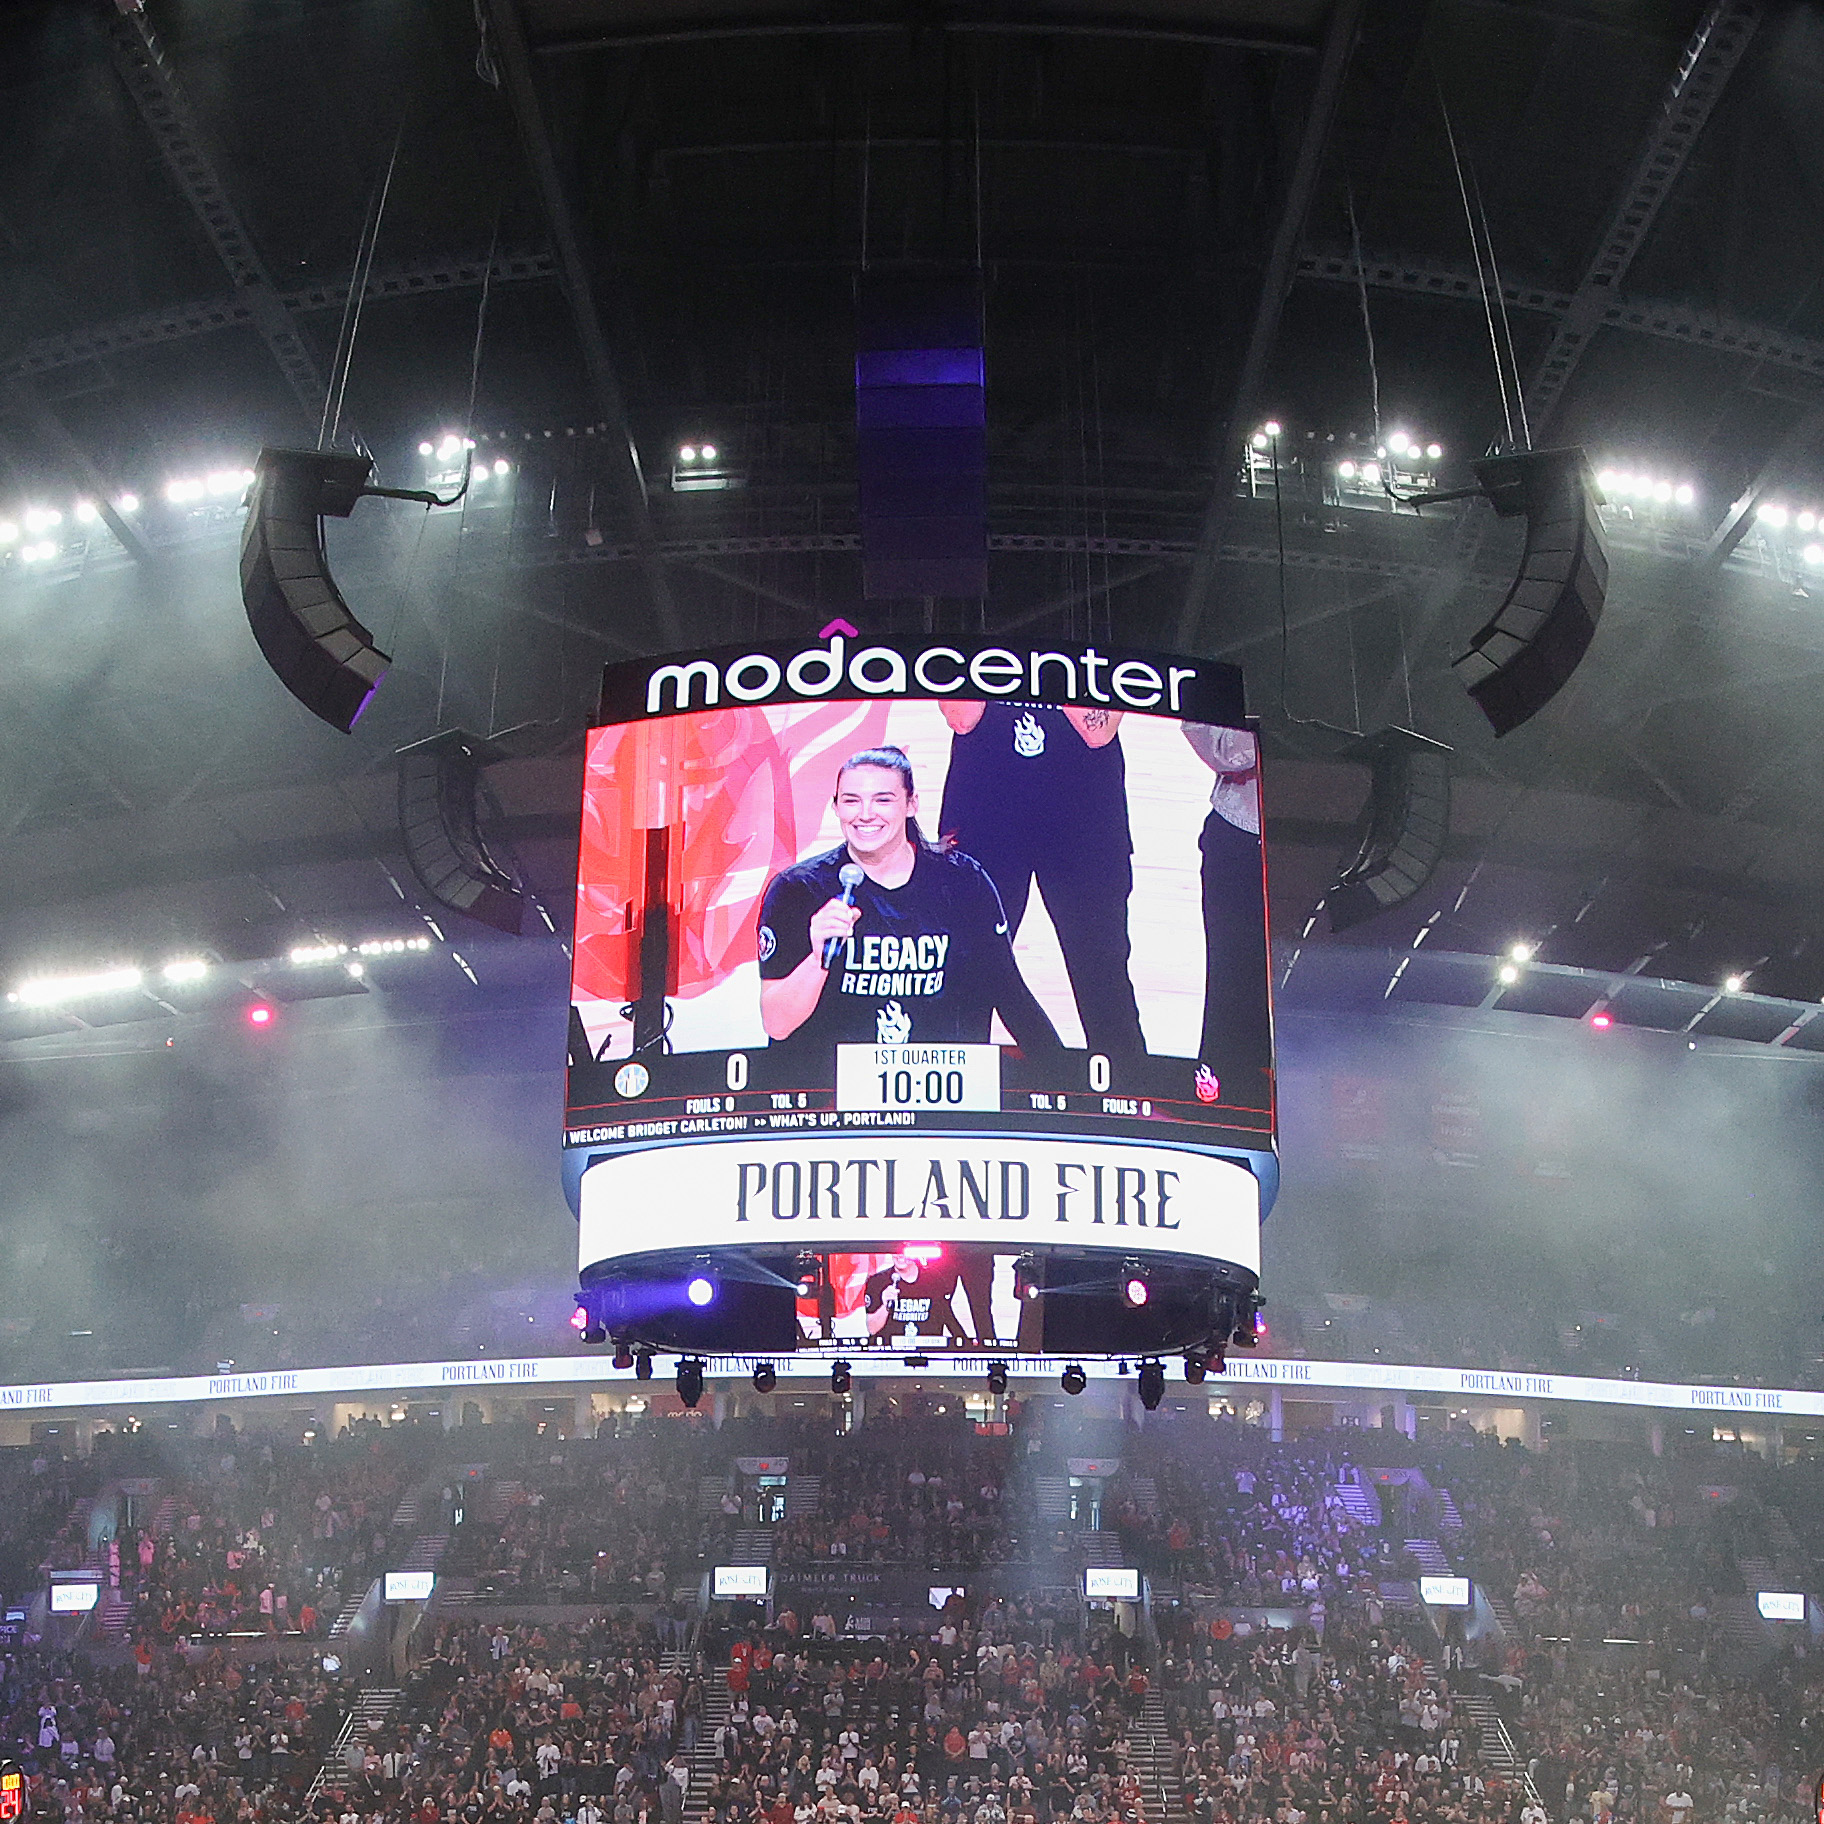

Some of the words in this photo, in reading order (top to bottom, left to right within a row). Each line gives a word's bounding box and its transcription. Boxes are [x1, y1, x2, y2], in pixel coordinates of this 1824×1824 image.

[647, 636, 1196, 712] modacenter
[845, 934, 949, 971] LEGACY
[840, 970, 945, 997] REIGNITED
[874, 1050, 898, 1066] 1ST
[902, 1050, 966, 1065] QUARTER
[727, 1053, 749, 1091] 0
[1088, 1054, 1110, 1092] 0
[878, 1070, 963, 1104] 10:00
[686, 1097, 721, 1114] FOULS
[725, 1096, 735, 1112] 0
[771, 1093, 793, 1109] TOL
[797, 1093, 807, 1108] 5
[1029, 1093, 1052, 1110] TOL
[1102, 1098, 1137, 1115] FOULS
[1142, 1100, 1152, 1116] 0
[570, 1128, 624, 1144] WELCOME
[628, 1120, 678, 1138] BRIDGET
[680, 1116, 747, 1134] CARLETON!
[769, 1113, 817, 1128] WHAT'S
[820, 1112, 841, 1127] UP,
[844, 1111, 916, 1126] PORTLAND!
[735, 1158, 1029, 1222] PORTLAND
[1054, 1162, 1181, 1230] FIRE
[894, 1298, 931, 1312] LEGACY
[442, 1364, 505, 1382] PORTLAND
[509, 1363, 538, 1379] FIRE
[953, 1358, 1018, 1374] PORTND
[209, 1376, 268, 1395] PORTLAND
[272, 1374, 298, 1390] FIRE
[1460, 1373, 1521, 1392] PORTLAND
[1525, 1377, 1554, 1393] FIRE
[26, 1387, 53, 1403] FIRE
[1691, 1389, 1751, 1408] PORTLAND
[1754, 1391, 1783, 1408] FIRE
[781, 1573, 836, 1583] DAIMLER
[842, 1573, 882, 1583] TRUCK
